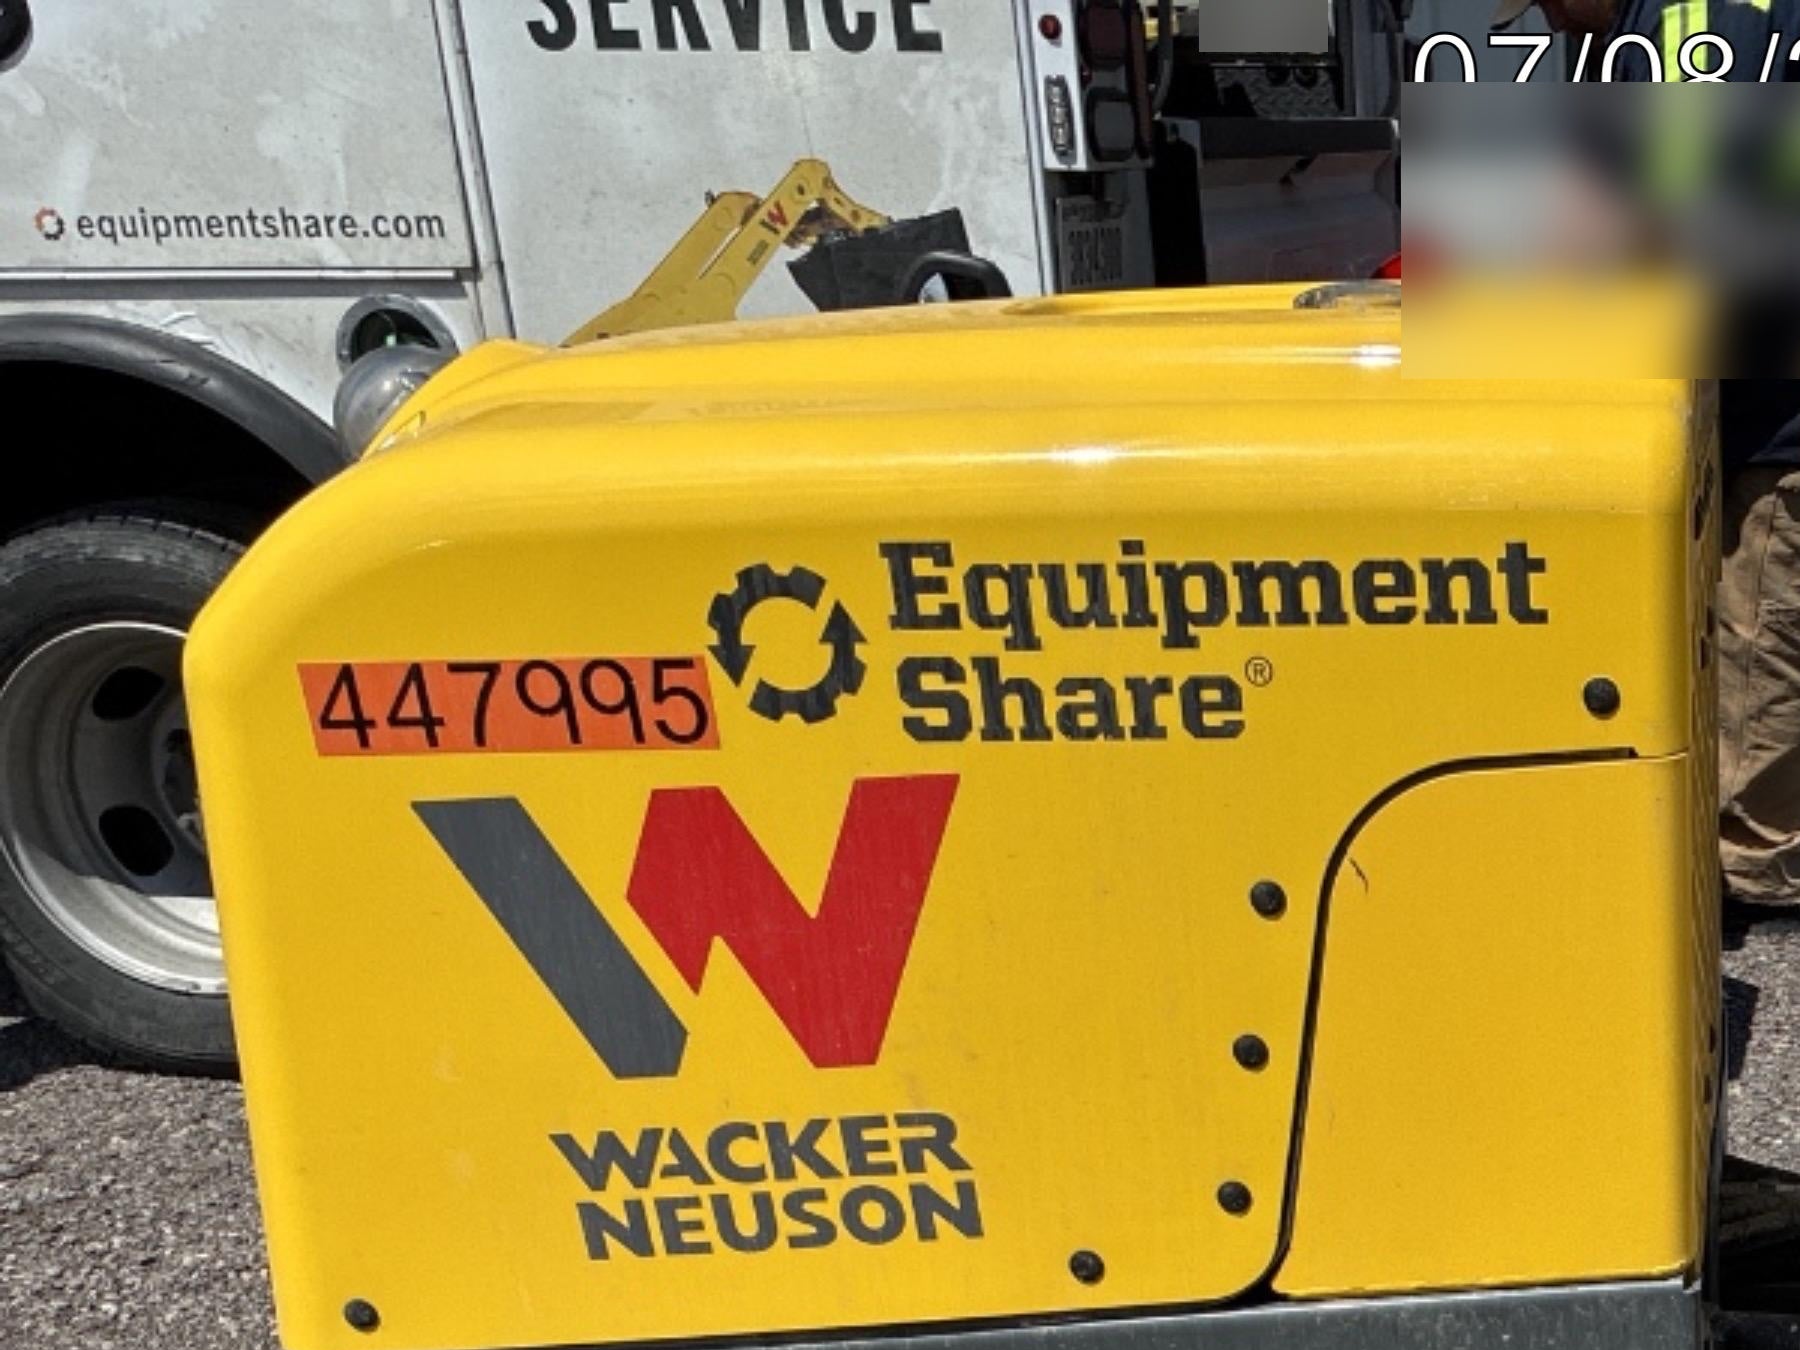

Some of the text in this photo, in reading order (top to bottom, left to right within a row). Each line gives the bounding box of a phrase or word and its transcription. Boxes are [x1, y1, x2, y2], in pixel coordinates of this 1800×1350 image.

[77, 207, 445, 245] equipmentshare.com
[878, 539, 1549, 652] Equipment
[319, 657, 709, 749] 447995
[548, 1111, 975, 1192] WACKER
[575, 1179, 985, 1261] NEUSON
